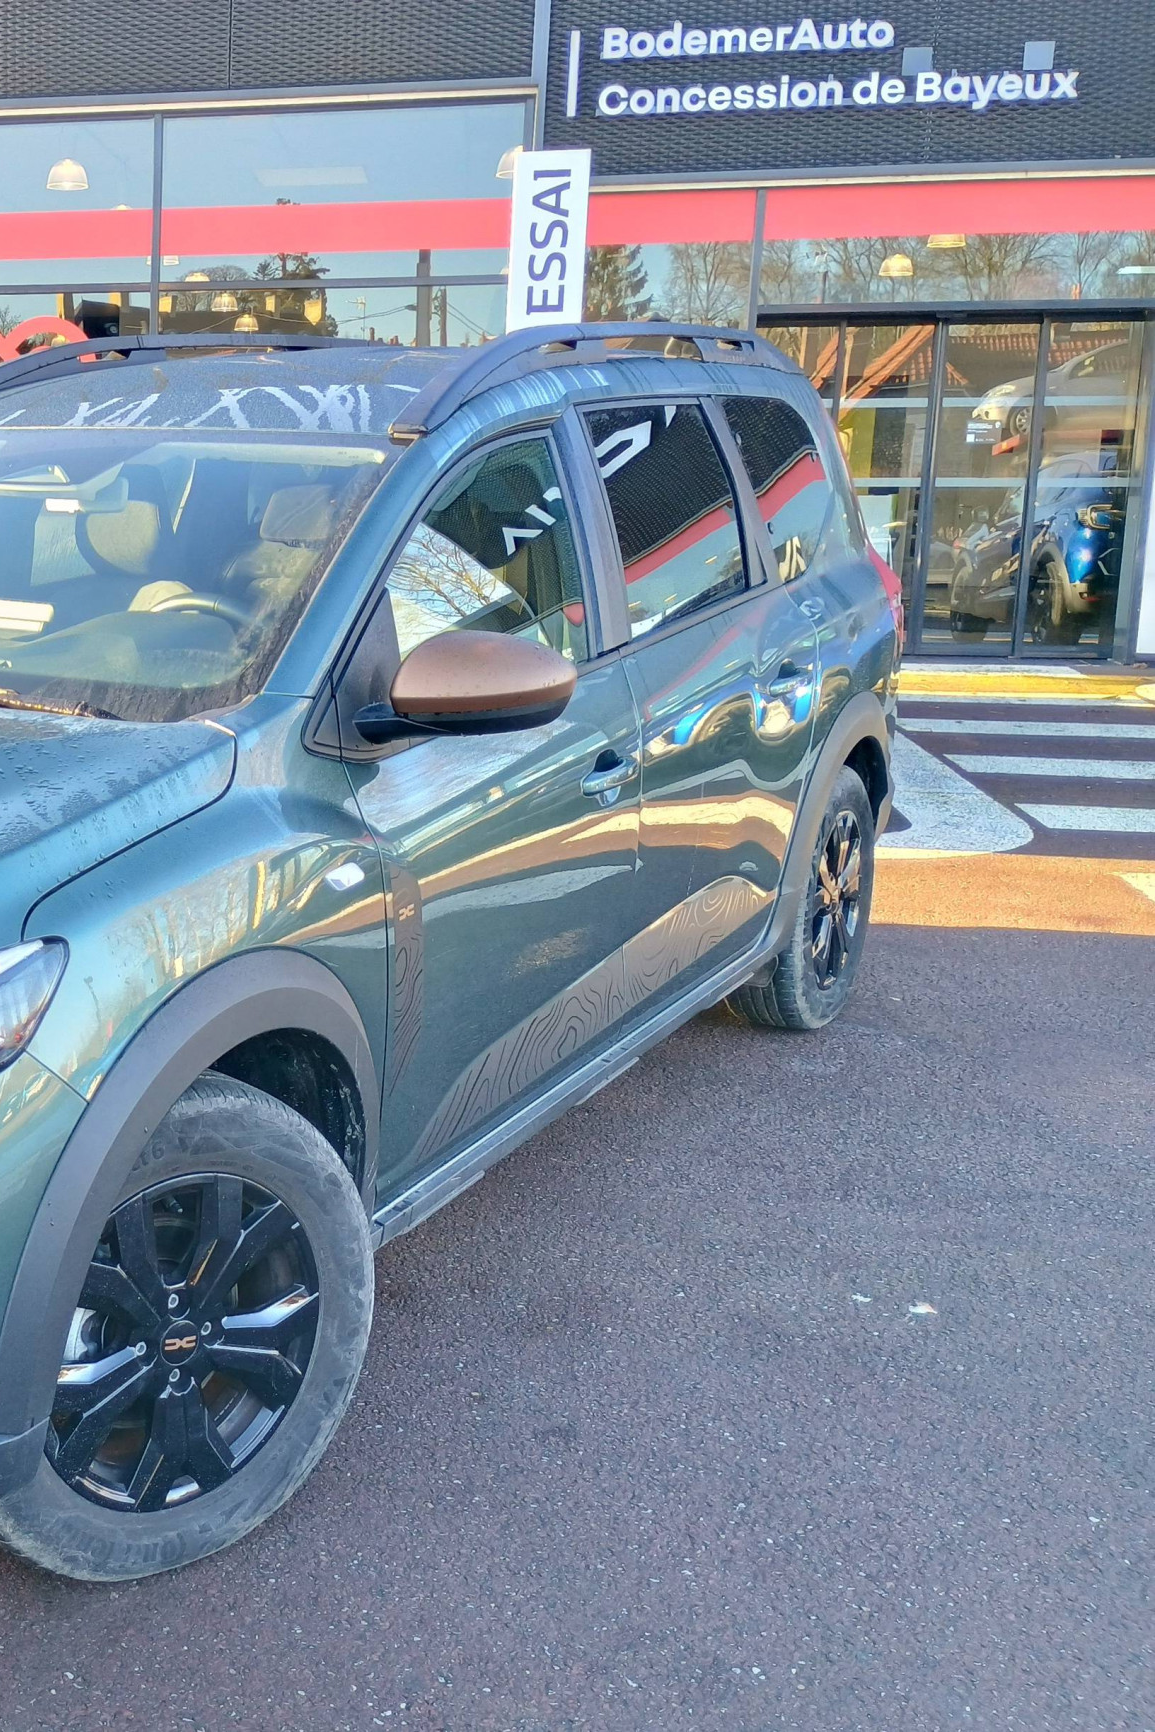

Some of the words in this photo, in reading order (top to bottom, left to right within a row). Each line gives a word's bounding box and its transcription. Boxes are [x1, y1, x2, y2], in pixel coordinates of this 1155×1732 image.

[602, 18, 895, 59] BodemerAuto
[598, 74, 843, 116] Concession
[852, 71, 905, 105] de
[916, 71, 1080, 110] Bayeux
[526, 169, 572, 315] ESSAI
